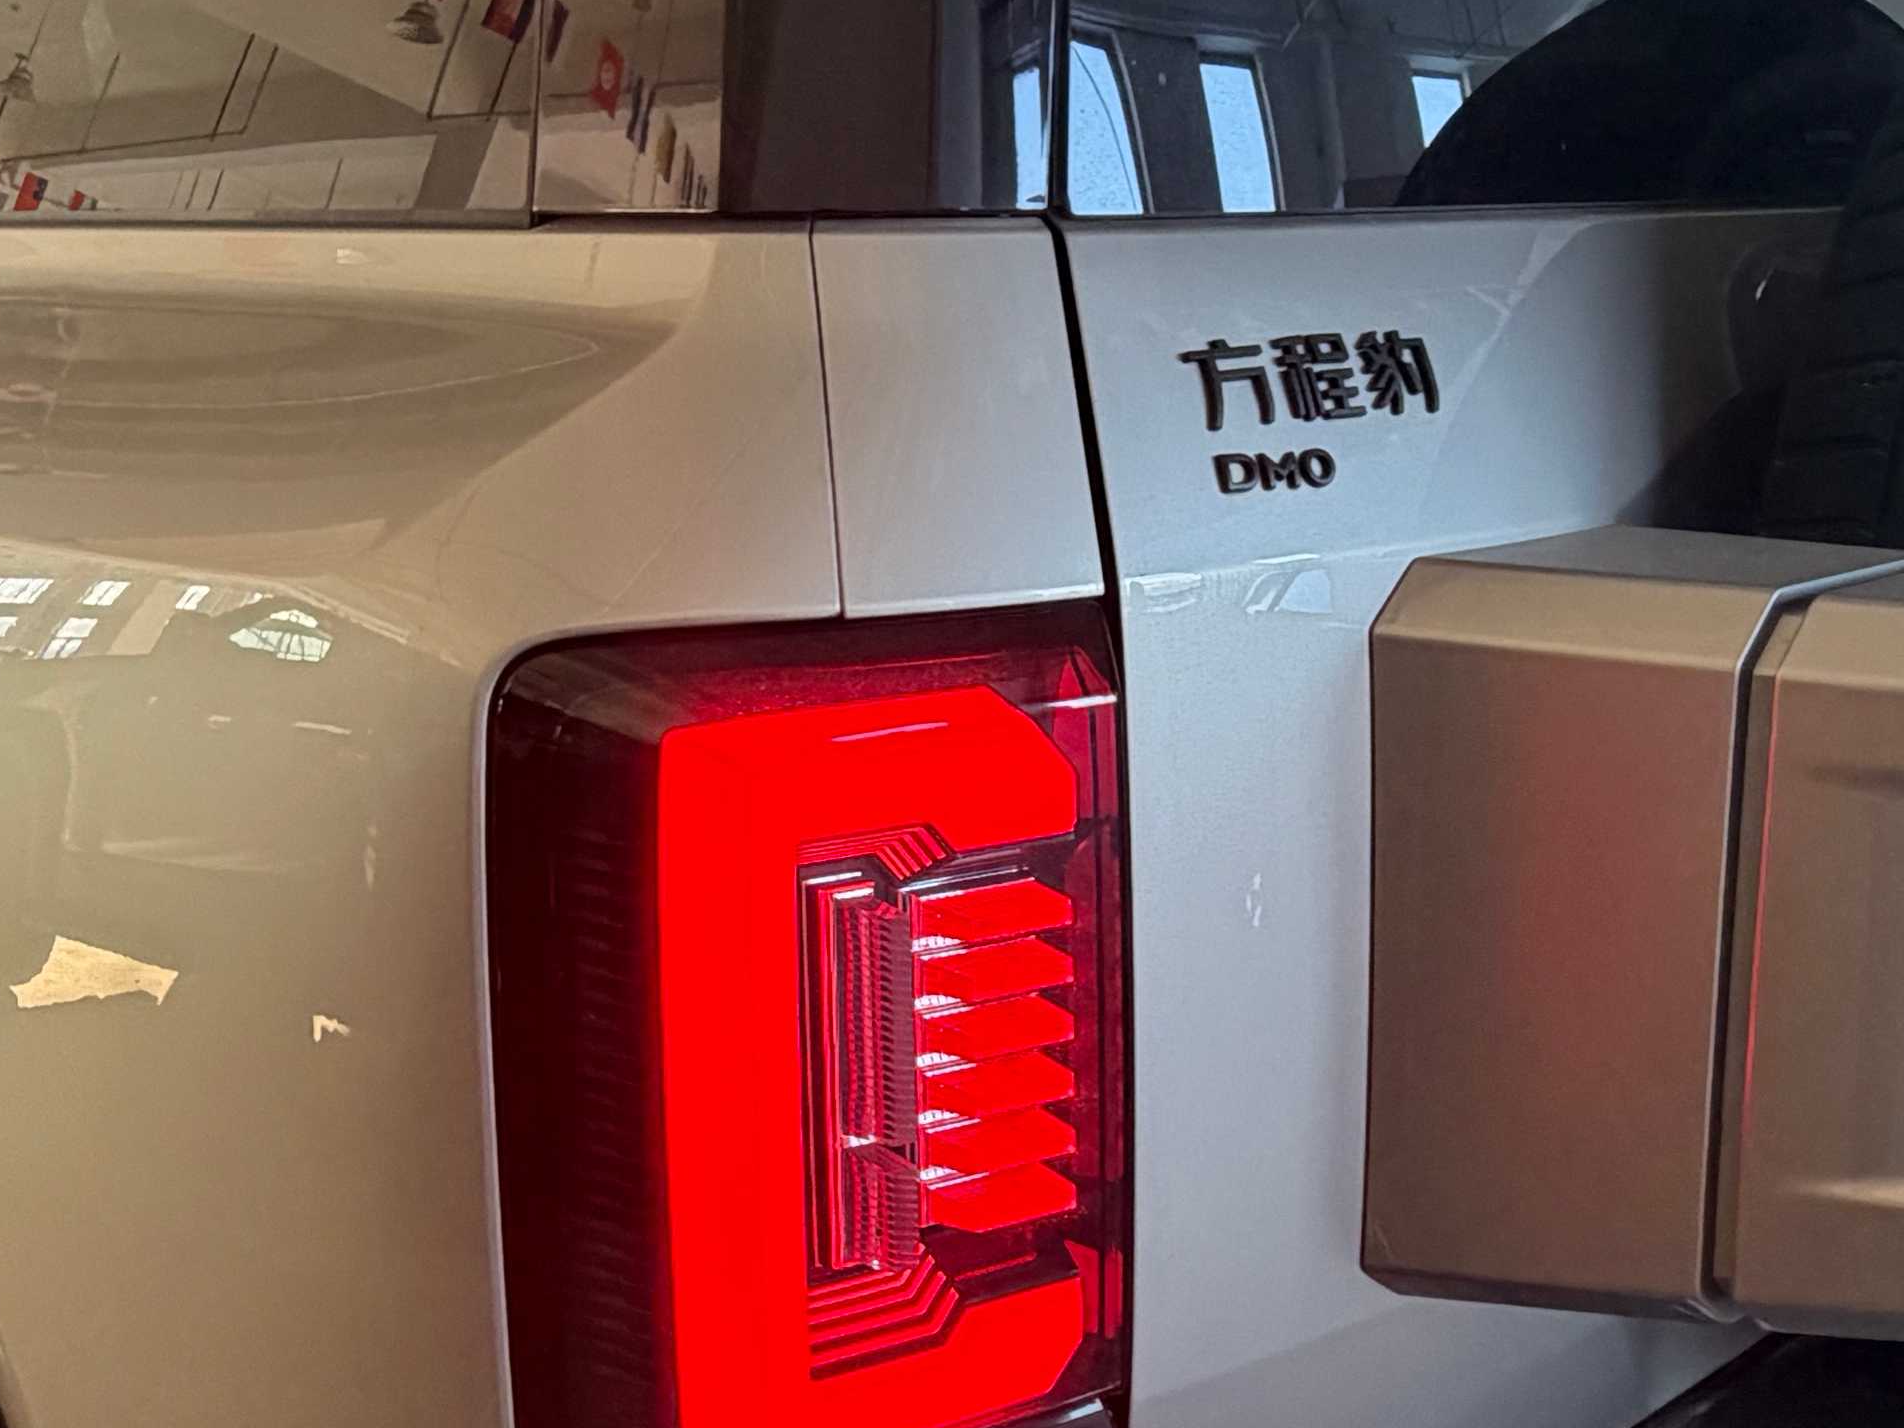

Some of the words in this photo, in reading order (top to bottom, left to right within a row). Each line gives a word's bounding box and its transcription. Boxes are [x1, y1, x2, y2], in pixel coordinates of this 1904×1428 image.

[1176, 329, 1440, 432] 方程豹
[1212, 447, 1337, 494] DMO
